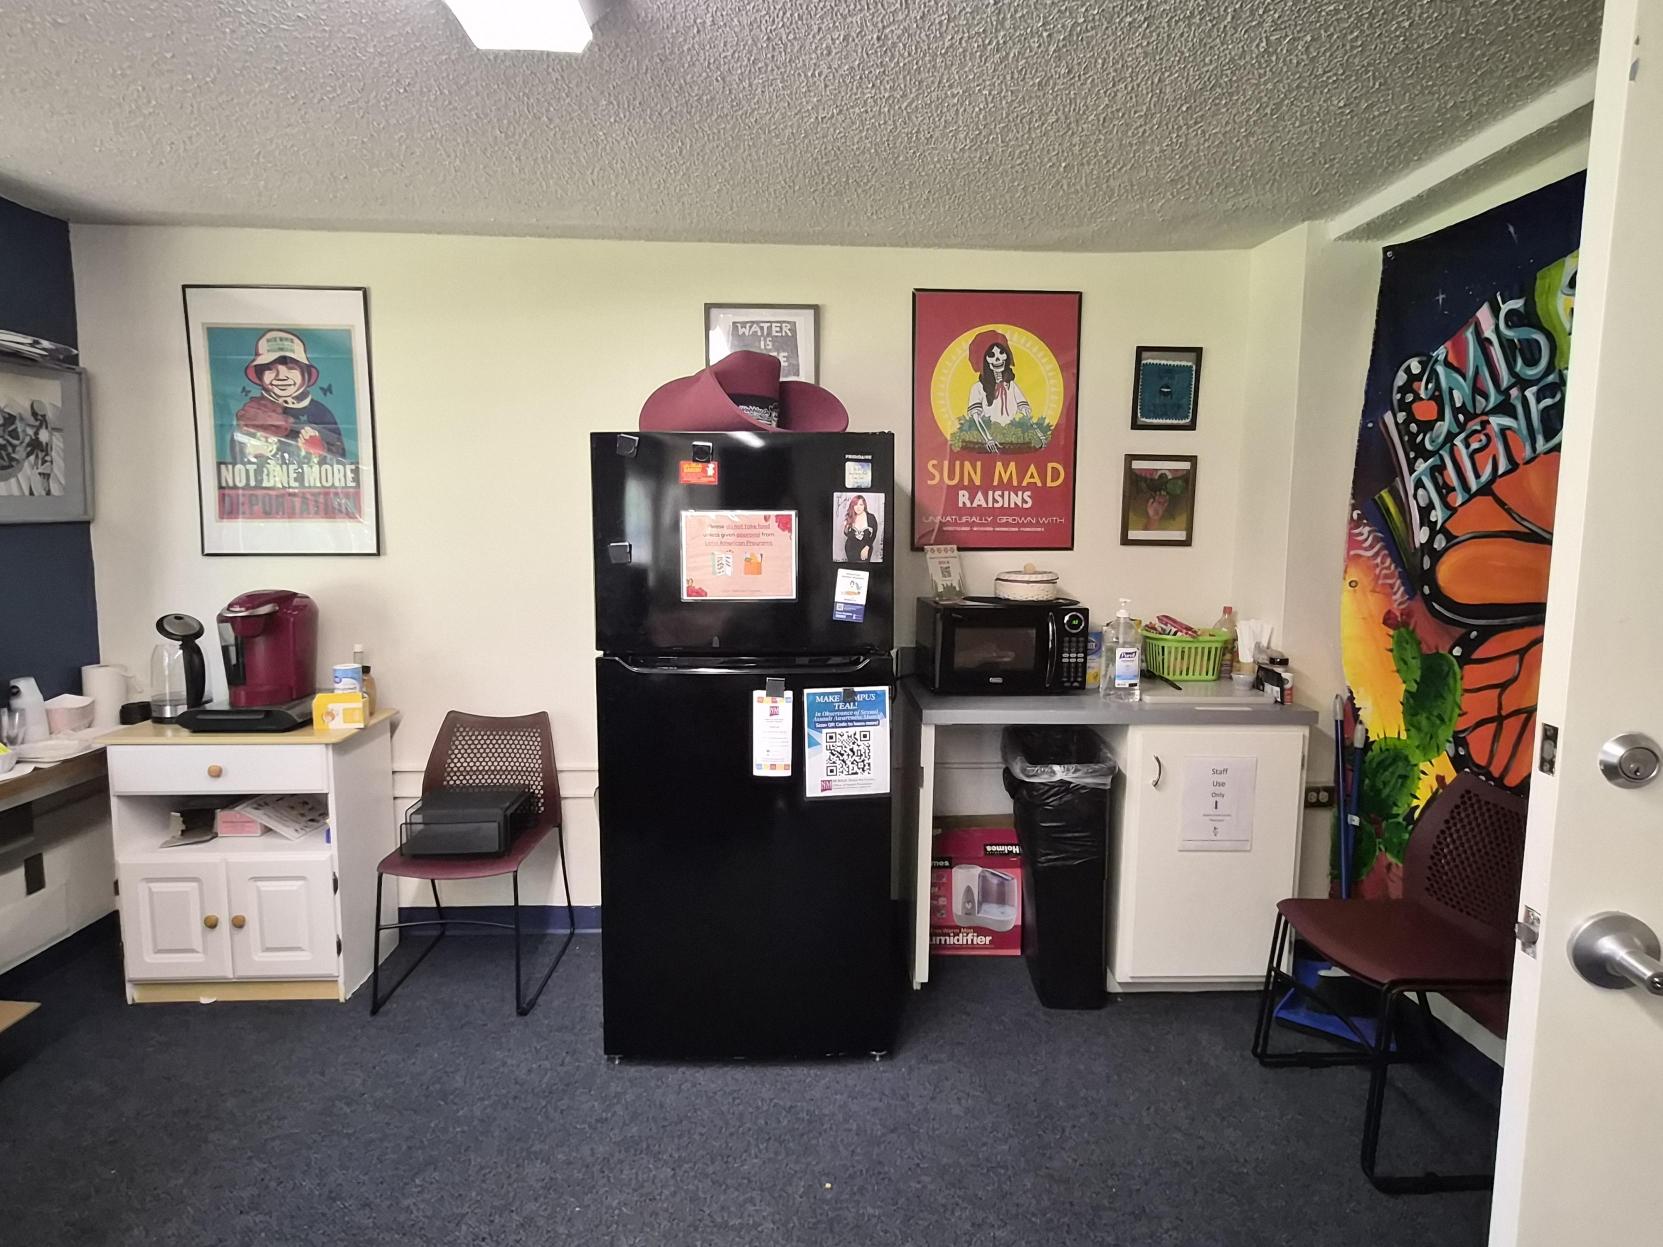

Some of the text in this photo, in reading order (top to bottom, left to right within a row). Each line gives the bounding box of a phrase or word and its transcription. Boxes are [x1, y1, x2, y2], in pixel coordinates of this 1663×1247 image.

[736, 323, 792, 336] WATER
[1420, 293, 1550, 450] MIS
[1411, 370, 1568, 530] TIENE
[220, 464, 356, 487] NOT ONE MORE
[927, 460, 1065, 487] SUN MAD
[958, 490, 1032, 508] RAISINS
[997, 516, 1036, 524] GROWN
[854, 693, 876, 701] MPUS
[834, 702, 858, 710] TEAL!
[986, 845, 1020, 853] Holmes
[929, 933, 992, 944] umidifier
